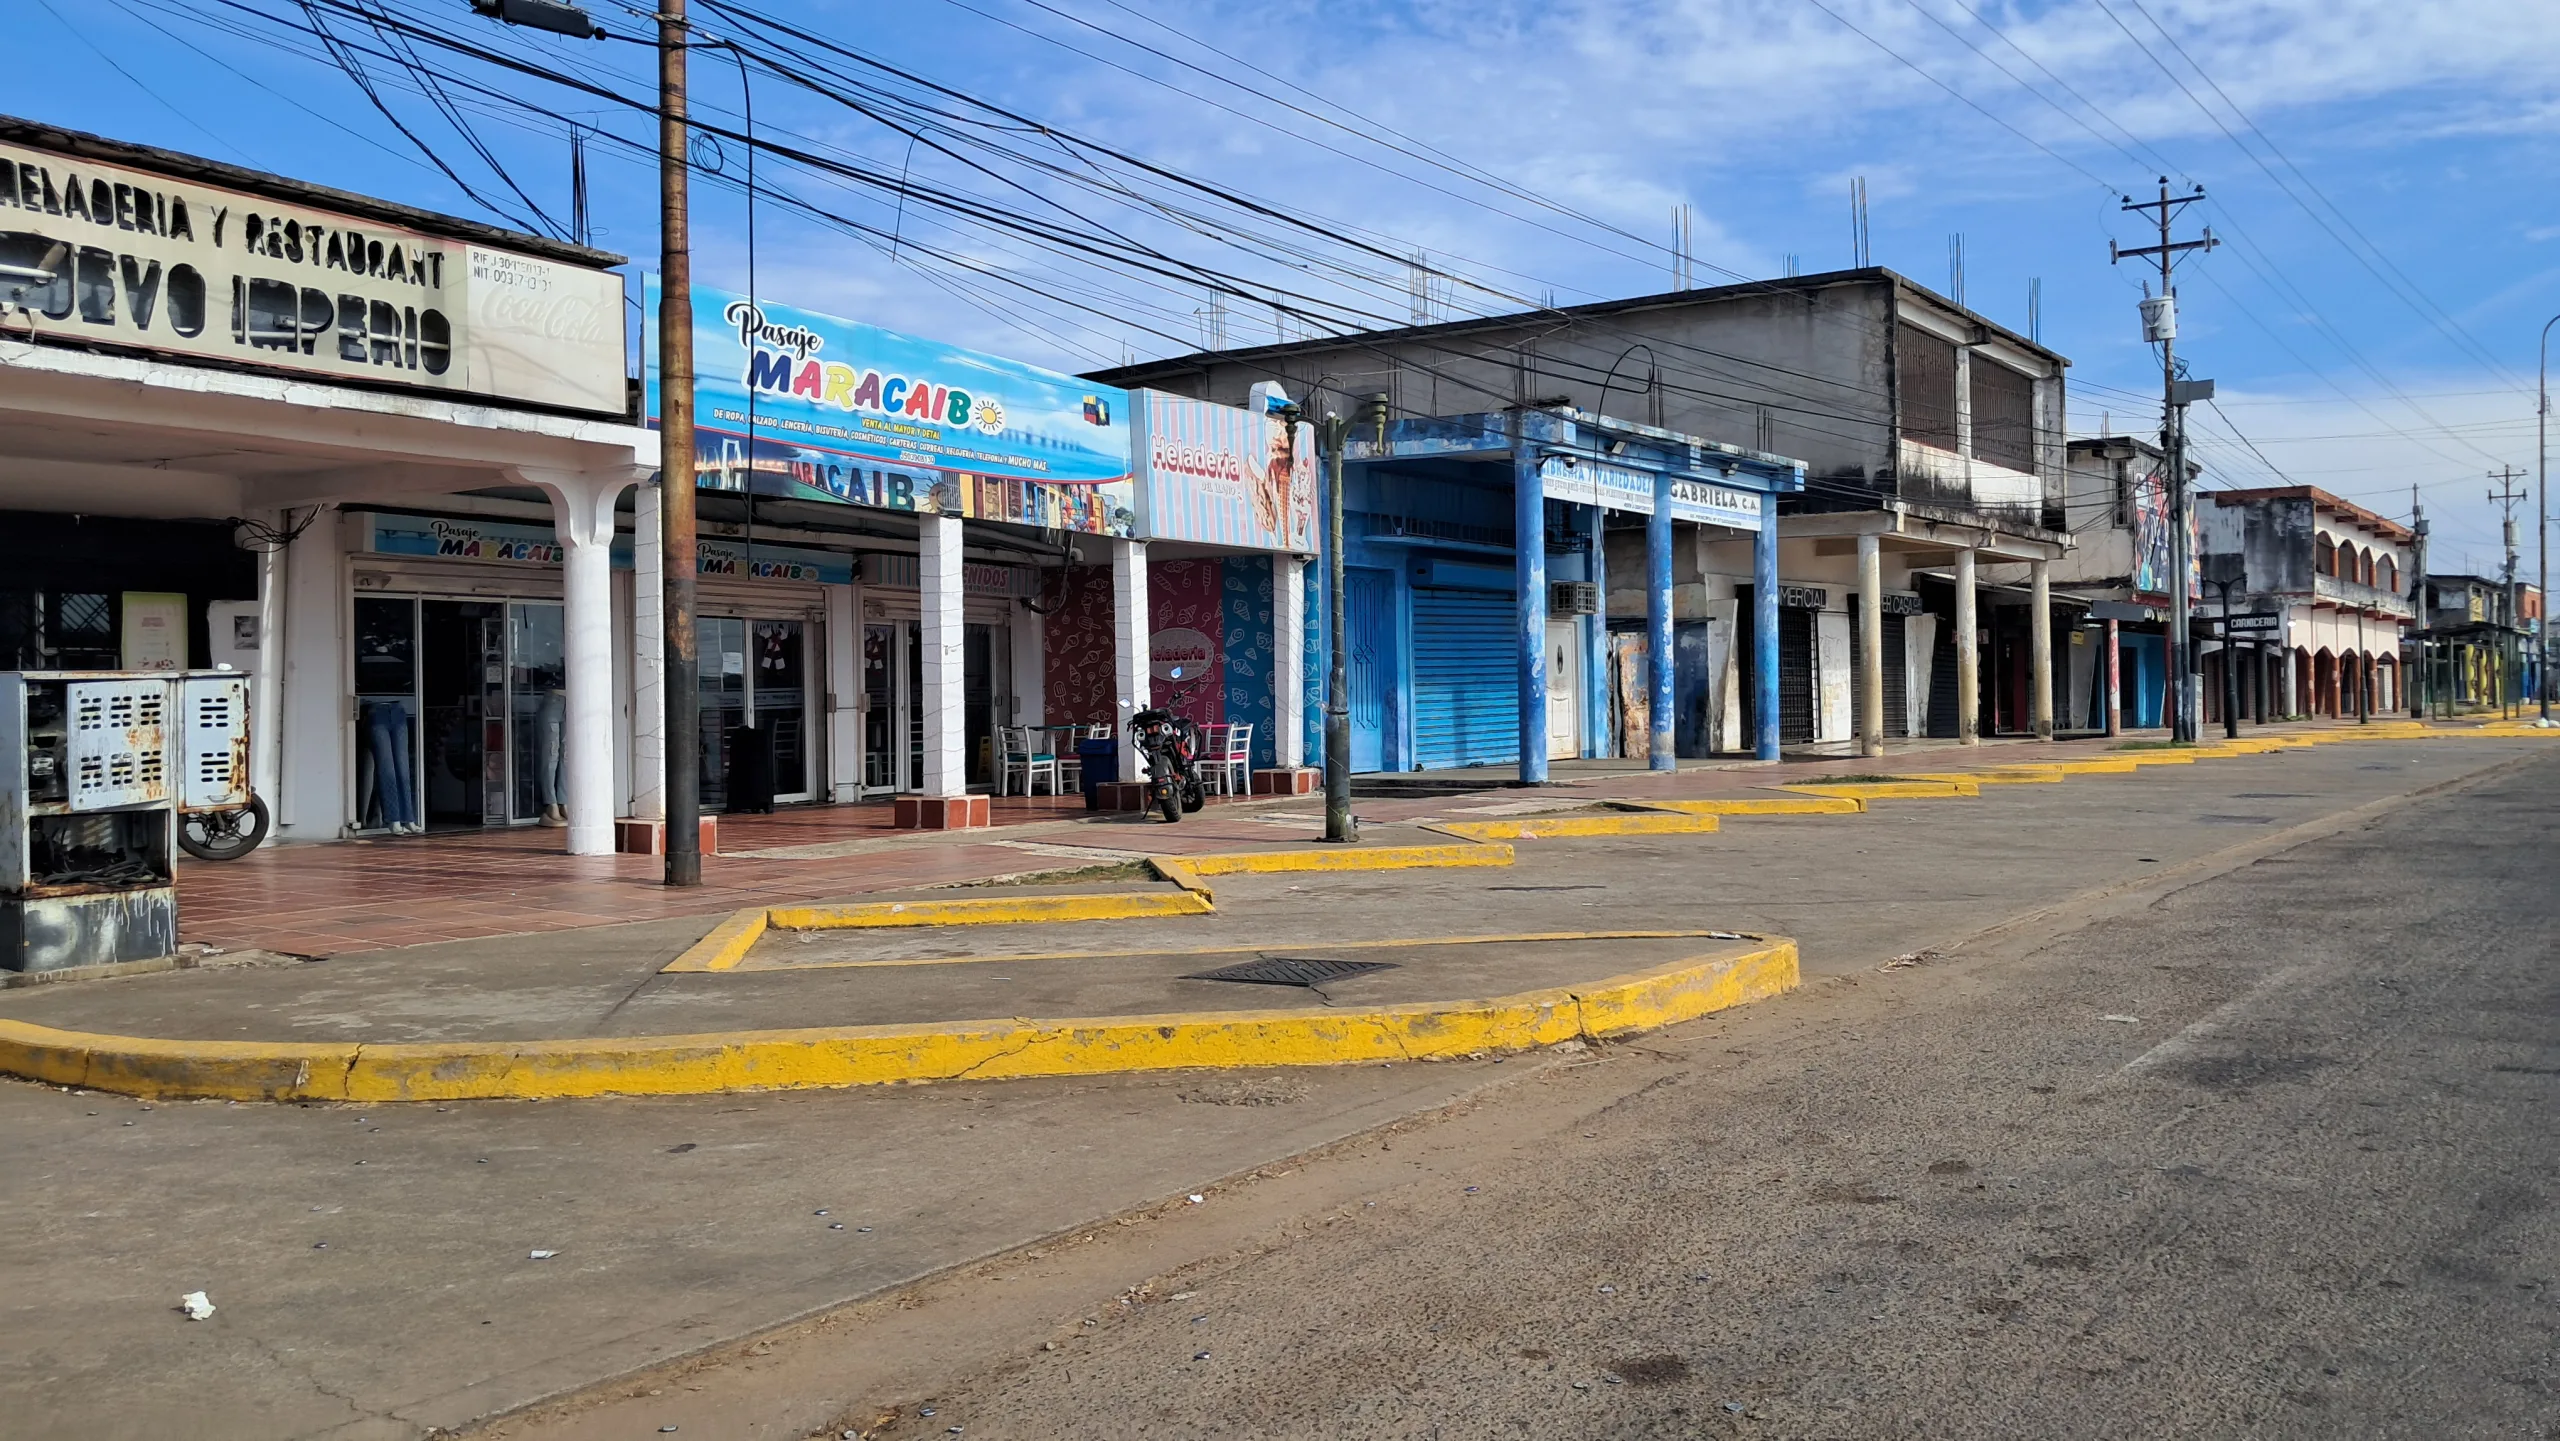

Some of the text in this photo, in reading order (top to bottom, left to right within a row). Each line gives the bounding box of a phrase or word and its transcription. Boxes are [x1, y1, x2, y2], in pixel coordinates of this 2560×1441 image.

[246, 212, 444, 290] RESTAURANT
[473, 252, 489, 265] RIF
[727, 303, 821, 360] Pasaje
[713, 408, 724, 420] DE
[724, 410, 747, 425] ROPA,
[1008, 456, 1032, 468] MUCHO
[861, 417, 941, 441] VENTA AL MAYOR Y DETAL
[1671, 481, 1738, 509] GABRIELA
[431, 520, 479, 542] Pasaje
[697, 542, 734, 560] Pasaje
[1893, 598, 1913, 614] CASA
